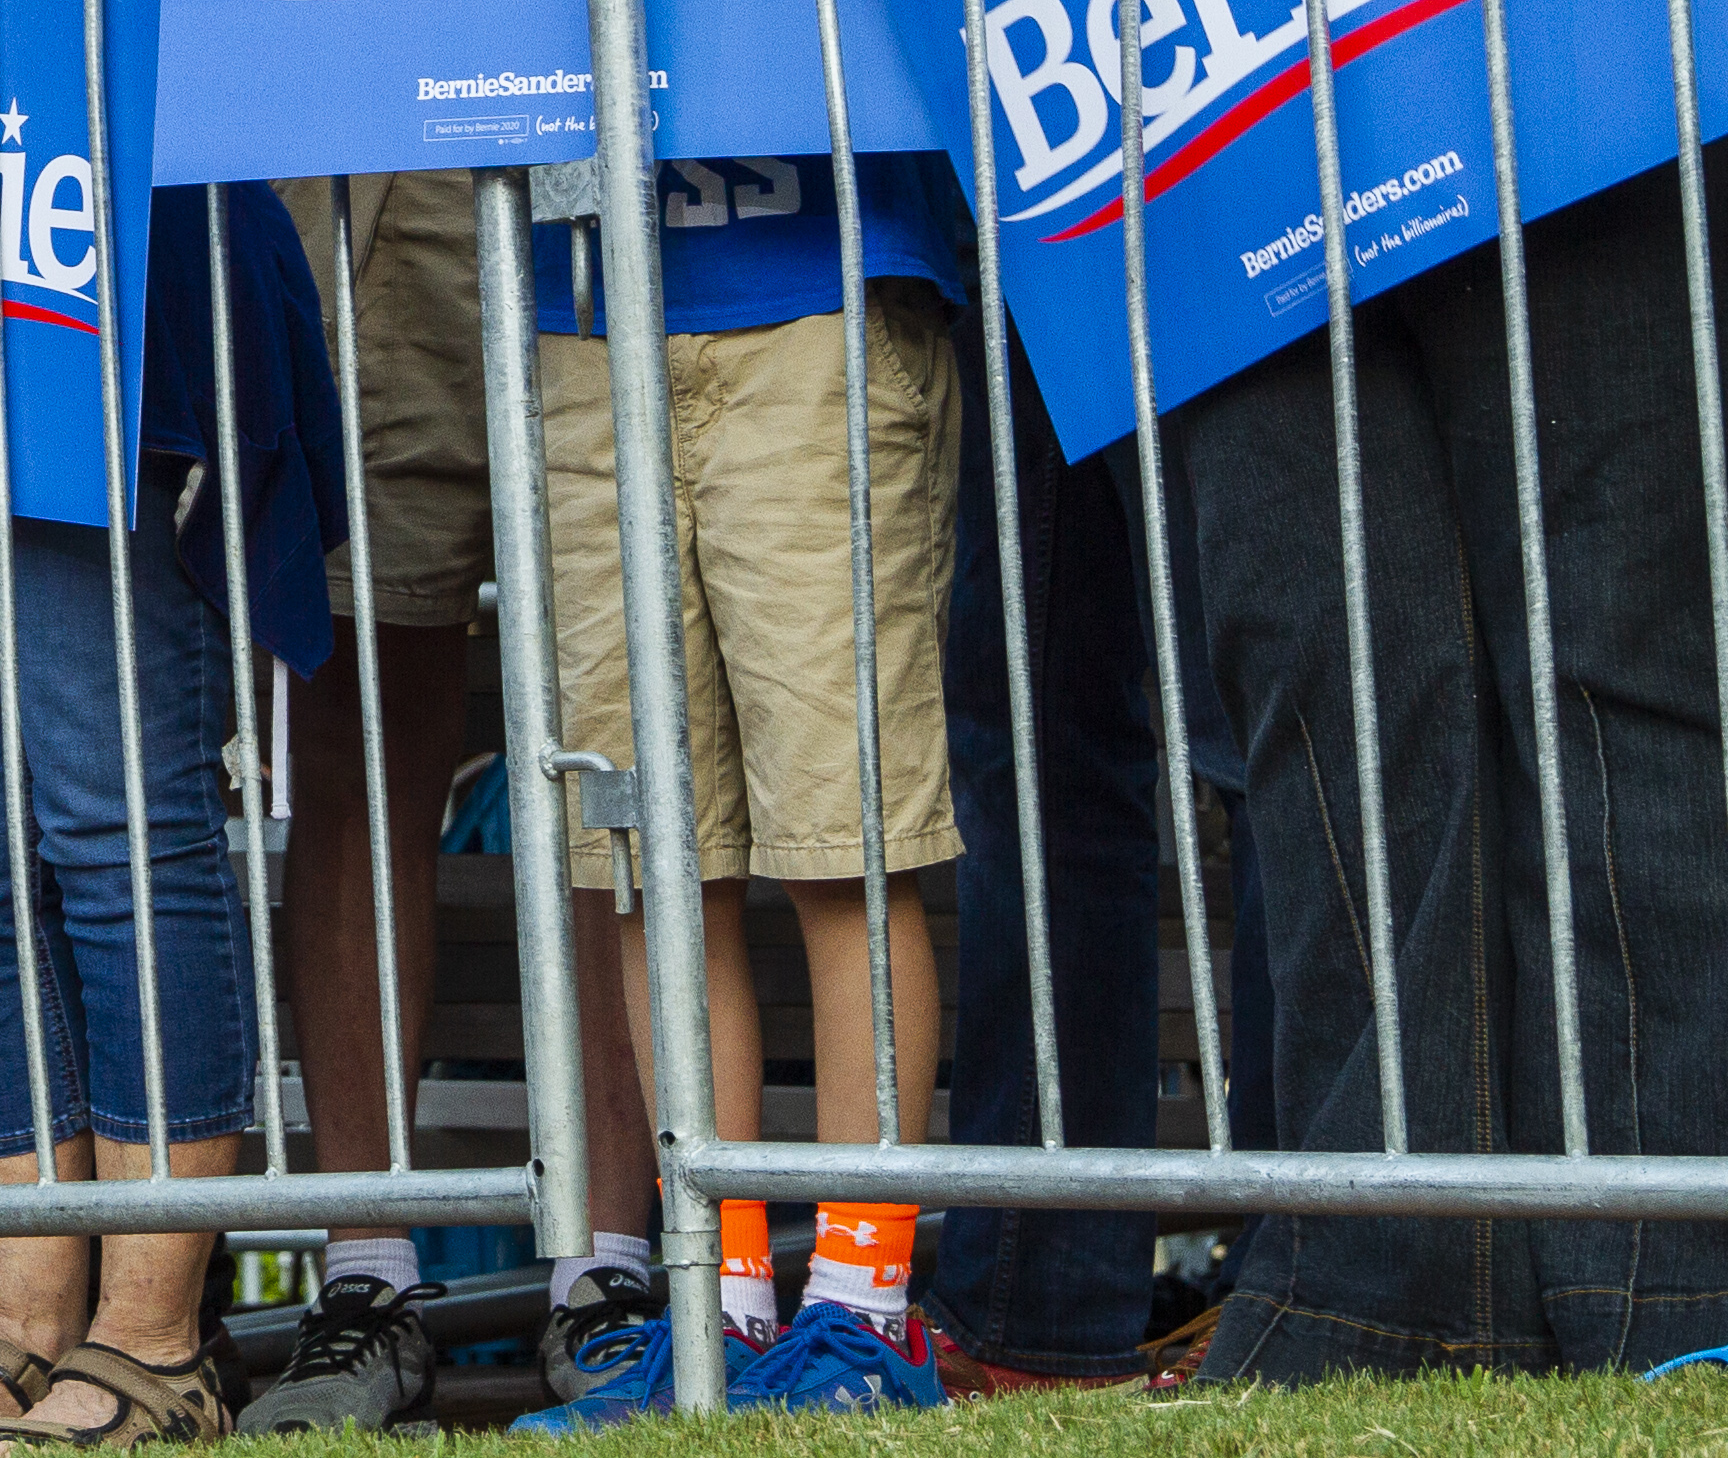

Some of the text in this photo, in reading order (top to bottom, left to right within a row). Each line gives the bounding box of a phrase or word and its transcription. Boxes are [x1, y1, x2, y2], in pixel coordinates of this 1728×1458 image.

[452, 123, 463, 133] for
[464, 123, 475, 135] by
[475, 122, 500, 133] Bernie
[501, 121, 520, 131] 2020
[536, 115, 561, 136] (not
[564, 117, 585, 132] the
